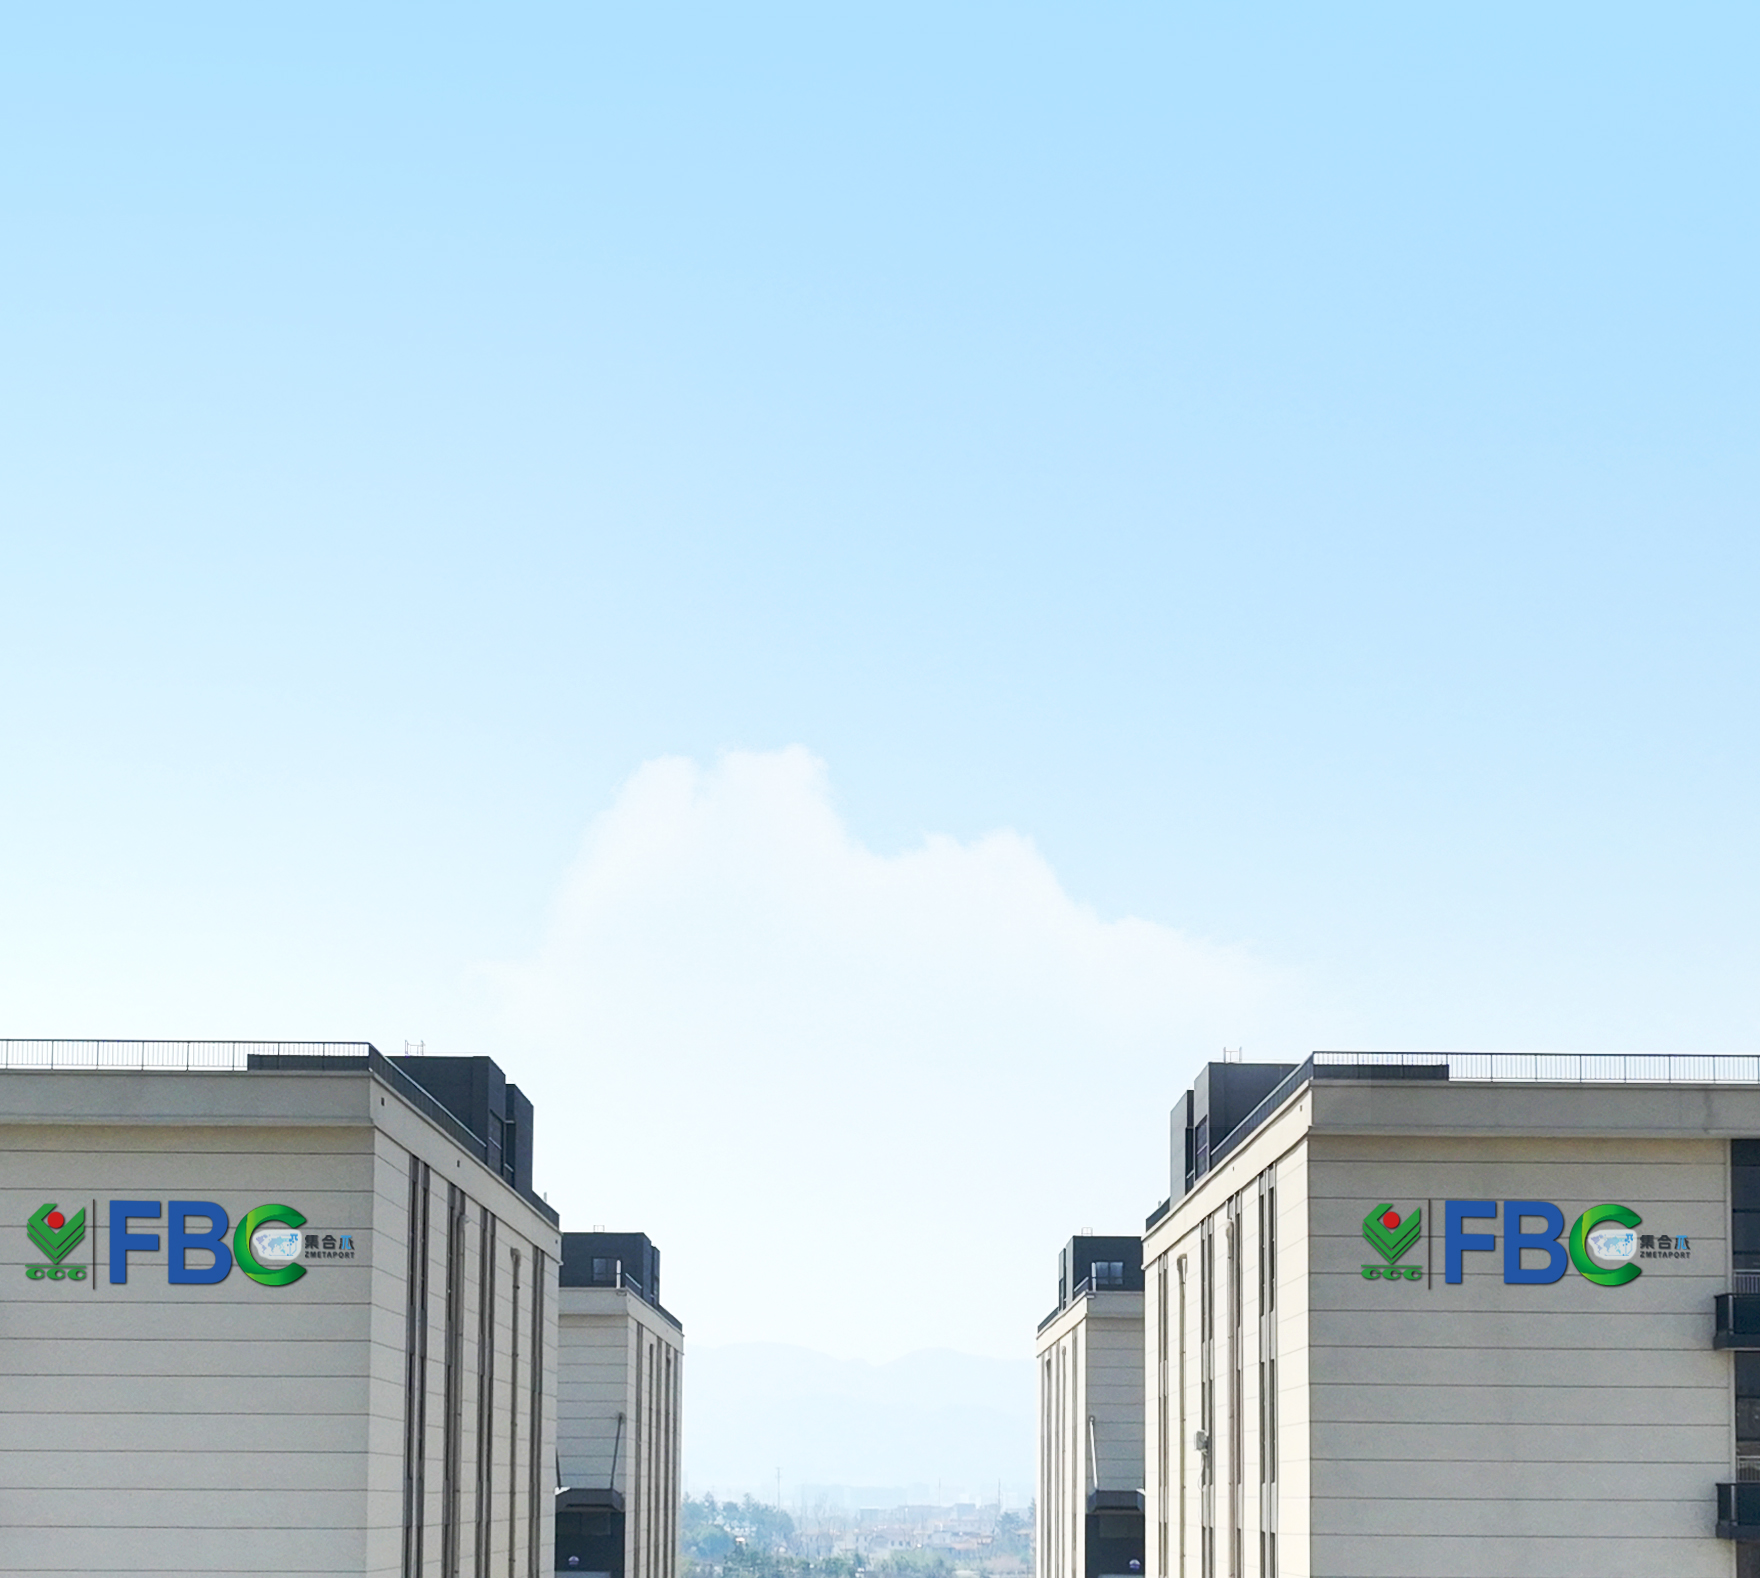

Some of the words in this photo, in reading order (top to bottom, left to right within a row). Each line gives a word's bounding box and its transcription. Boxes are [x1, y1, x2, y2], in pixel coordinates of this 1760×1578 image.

[109, 1200, 307, 1287] FBC
[305, 1251, 355, 1259] ZMETAPORT
[1445, 1200, 1642, 1287] FBC
[1640, 1251, 1691, 1259] ZMETAPORT
